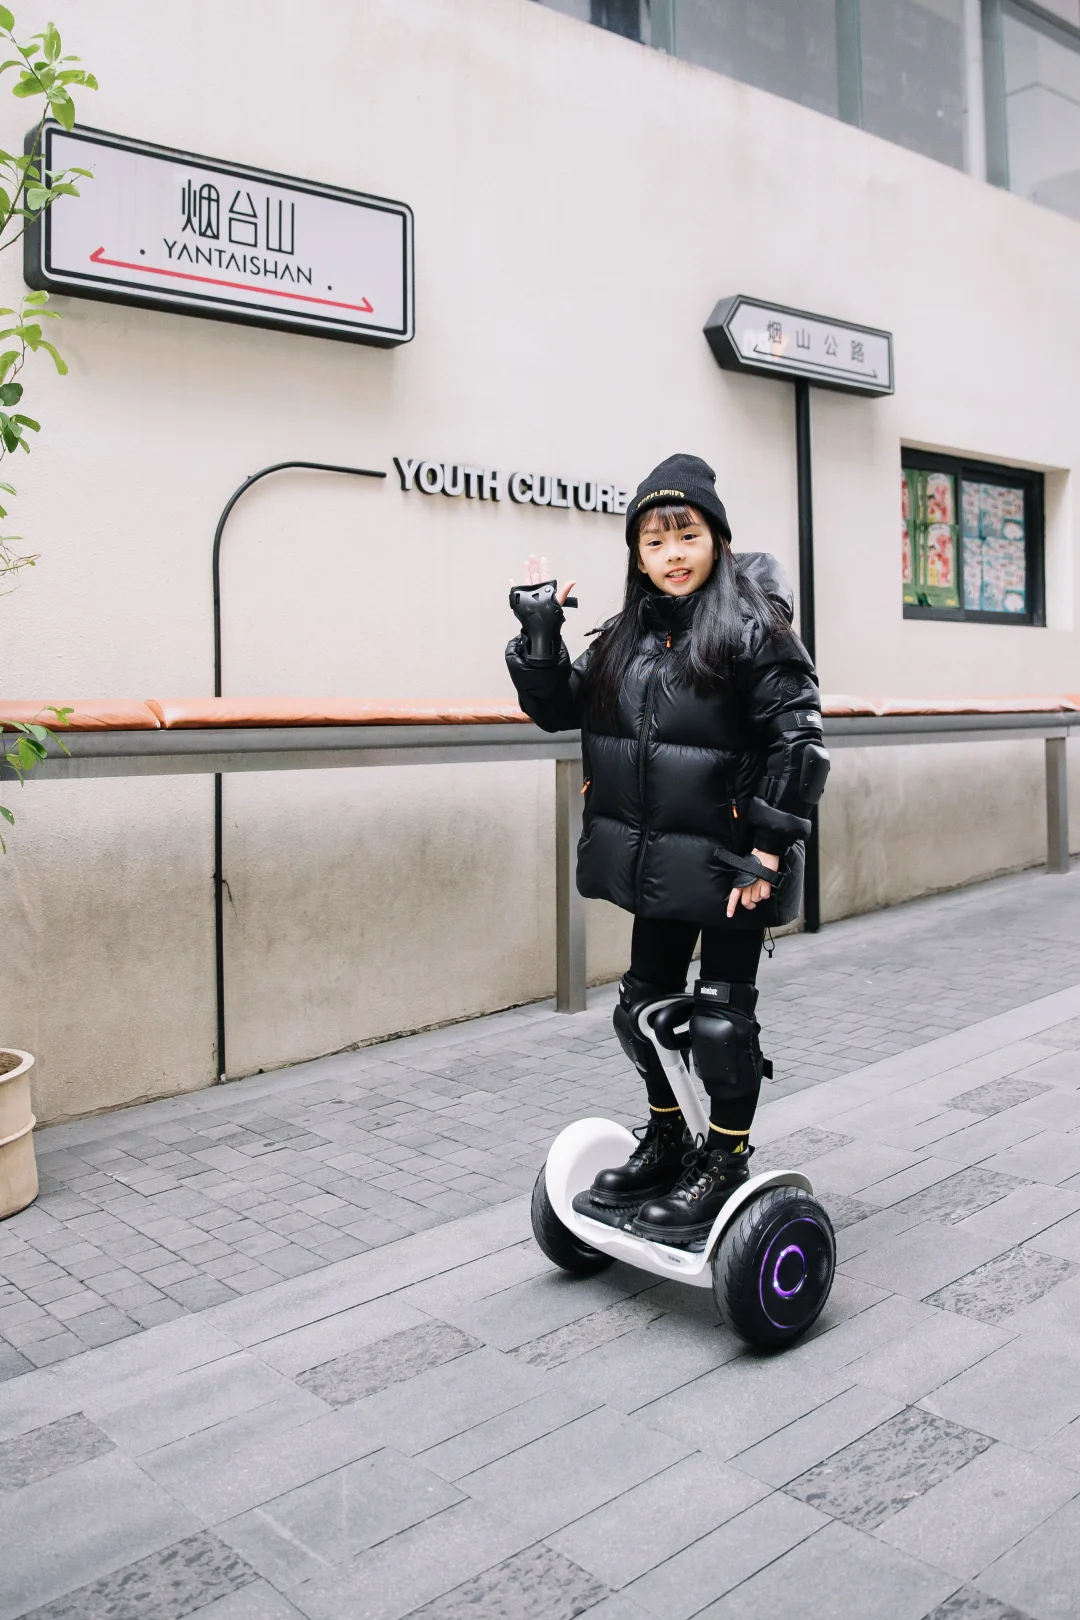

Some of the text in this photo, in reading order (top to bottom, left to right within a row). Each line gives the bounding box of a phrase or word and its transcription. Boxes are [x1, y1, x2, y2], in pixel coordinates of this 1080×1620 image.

[181, 179, 295, 255] 烟台山
[163, 238, 312, 285] YANTAISHAN
[766, 320, 864, 363] 烟山公路
[394, 457, 630, 514] YOUTH CULTURE
